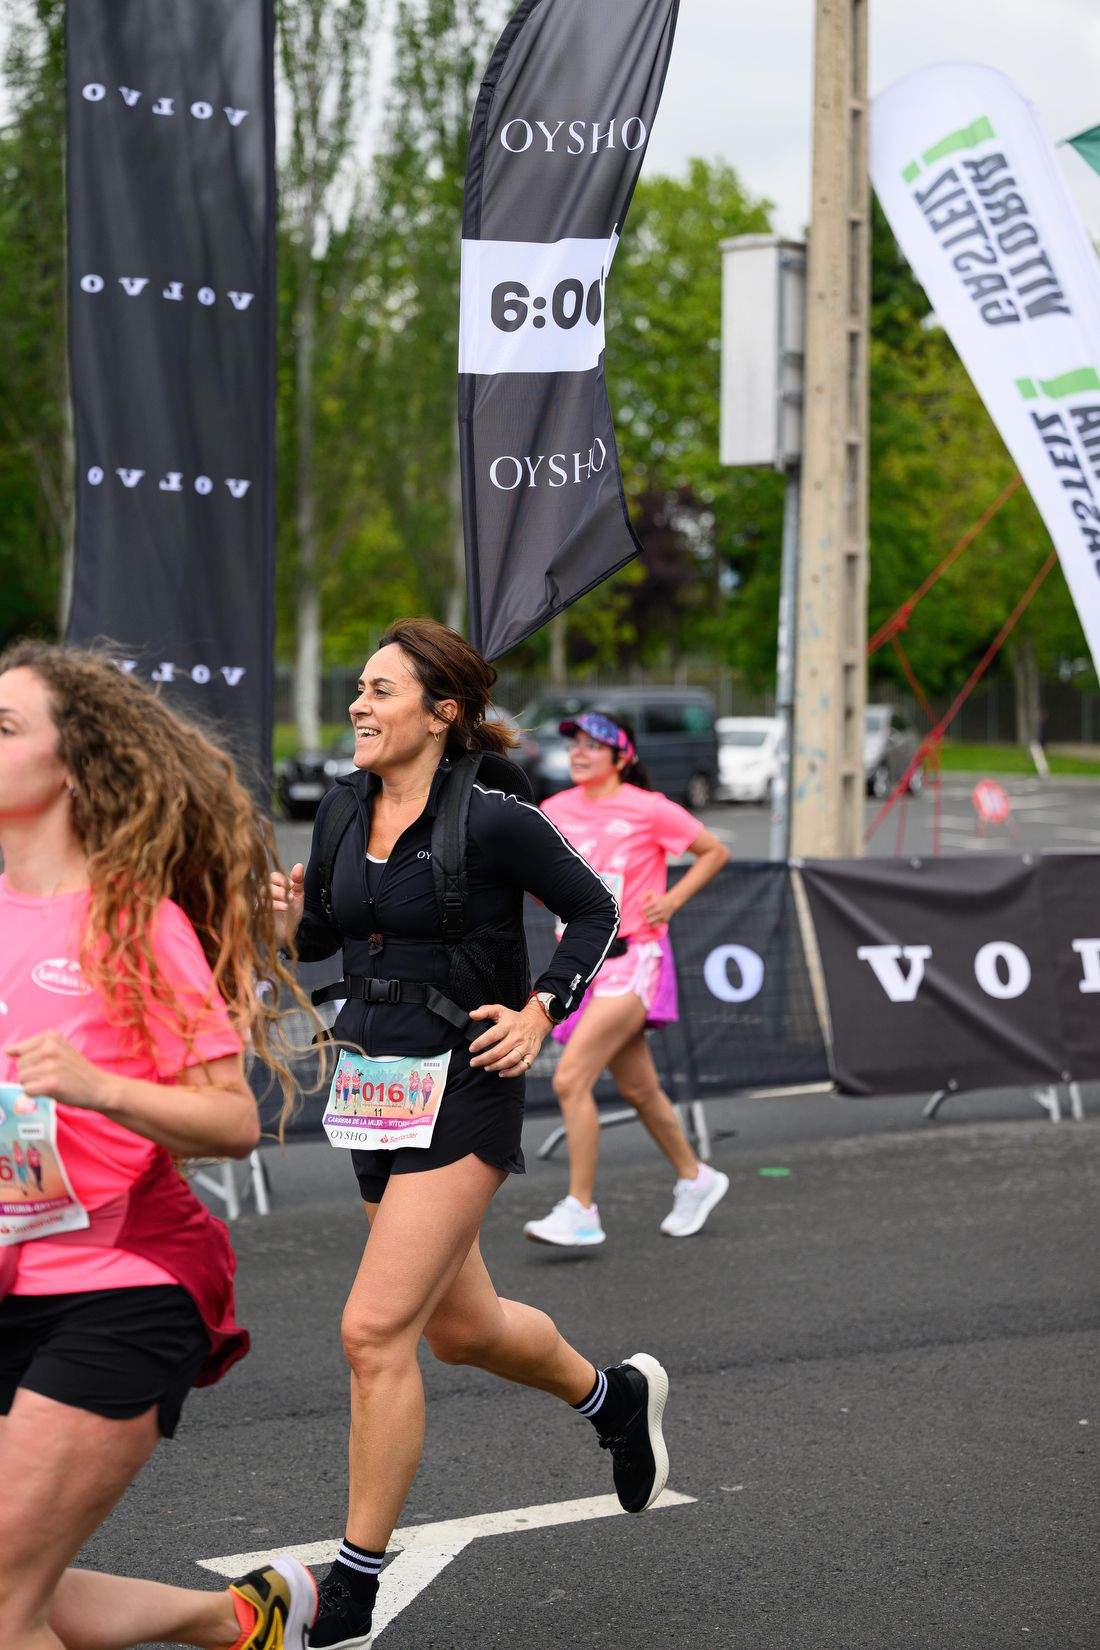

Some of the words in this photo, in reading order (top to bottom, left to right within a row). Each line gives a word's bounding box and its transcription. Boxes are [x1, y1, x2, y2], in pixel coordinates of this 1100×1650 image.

[500, 116, 647, 155] OYSHO
[489, 437, 607, 490] OYSHO
[362, 1081, 405, 1103] 016
[374, 1108, 382, 1117] 11
[330, 1129, 368, 1142] OYSHO
